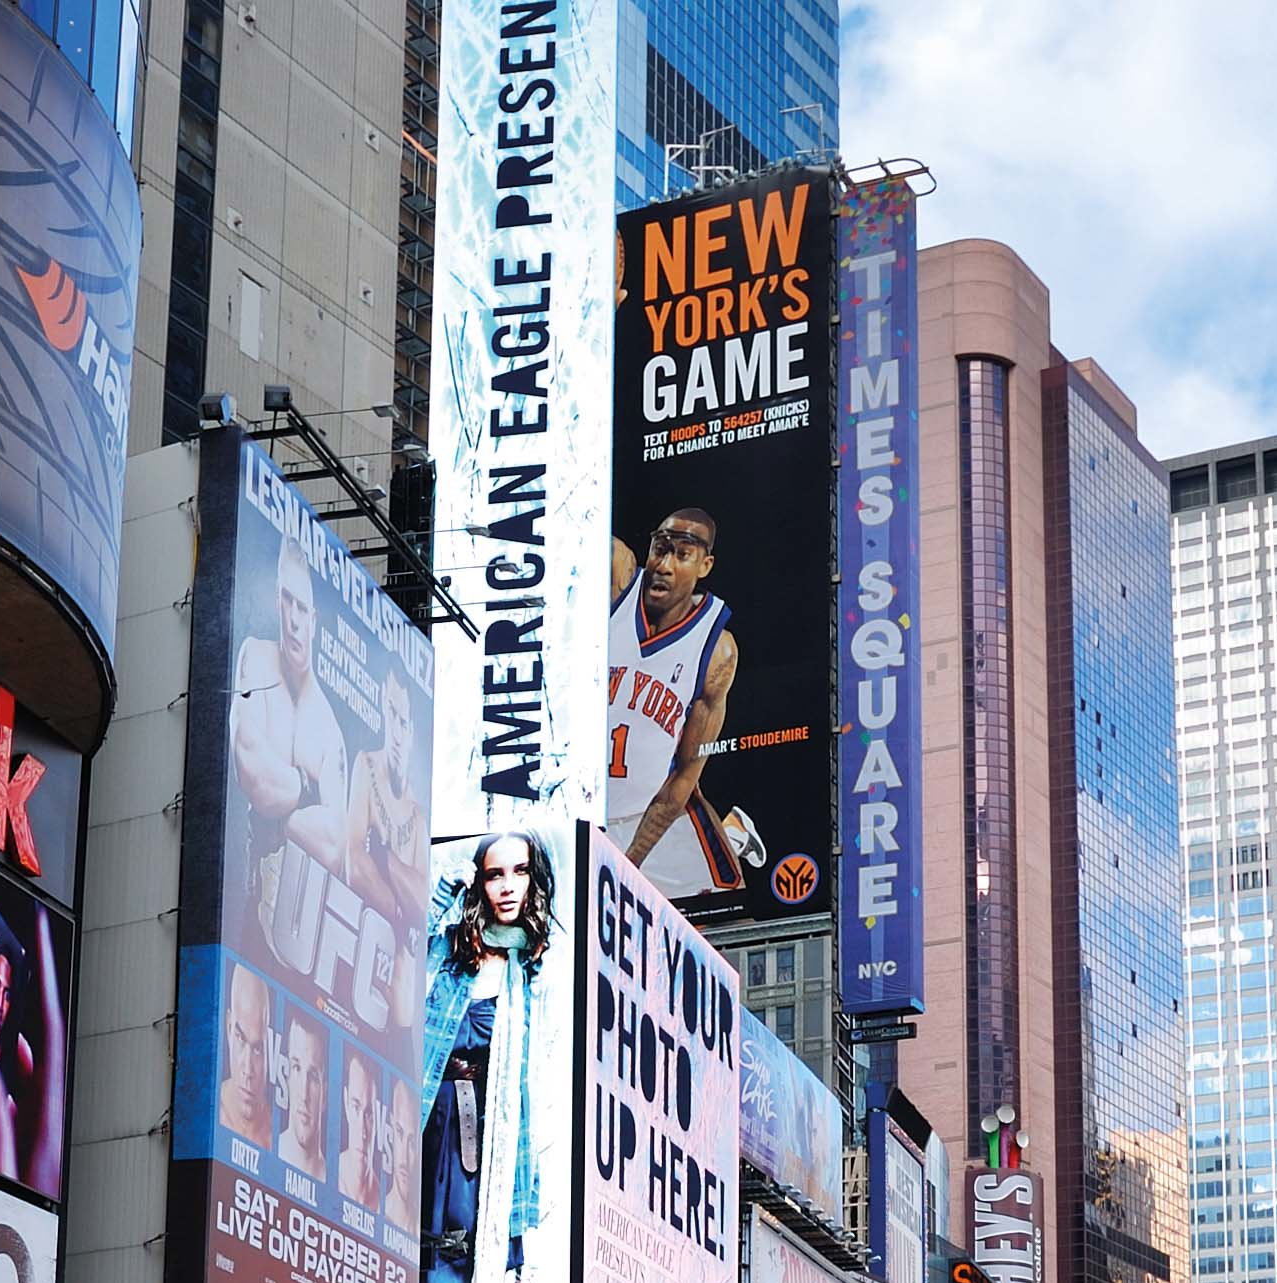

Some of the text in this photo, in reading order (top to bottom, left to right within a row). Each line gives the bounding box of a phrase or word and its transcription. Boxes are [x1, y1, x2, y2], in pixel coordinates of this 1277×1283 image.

[644, 184, 809, 301] NEW
[490, 251, 551, 439] EAGLE
[645, 268, 810, 354] YORK'S
[642, 322, 809, 423] GAME
[848, 252, 899, 526] TIMES
[643, 413, 809, 462] FOR A CHANCE TO MEET AMAR'E
[644, 399, 810, 447] TEXT HOOPS TO 564257 (KNICKS)
[245, 446, 434, 699] LESNAR VELASQUEZ
[337, 615, 367, 664] WORLD
[480, 464, 548, 801] AMERICAN
[628, 670, 683, 737] YORK
[698, 726, 810, 757] AMAR'E STOUDEMIRE
[850, 560, 904, 919] SQUARE
[273, 838, 396, 1033] UFC
[597, 863, 734, 1070] GET YOUR
[858, 960, 897, 979] NYC
[596, 970, 693, 1132] PHOTO
[232, 1137, 259, 1176] ORTIZ
[285, 1168, 317, 1207] HAMILL
[595, 1083, 725, 1262] UP HERE!
[217, 1201, 262, 1249] LIVE
[269, 1228, 299, 1268] ON
[235, 1179, 282, 1229] SAT.
[289, 1208, 381, 1280] OCTOBER
[343, 1201, 375, 1238] SHIELDS
[646, 1233, 674, 1274] EAGLE
